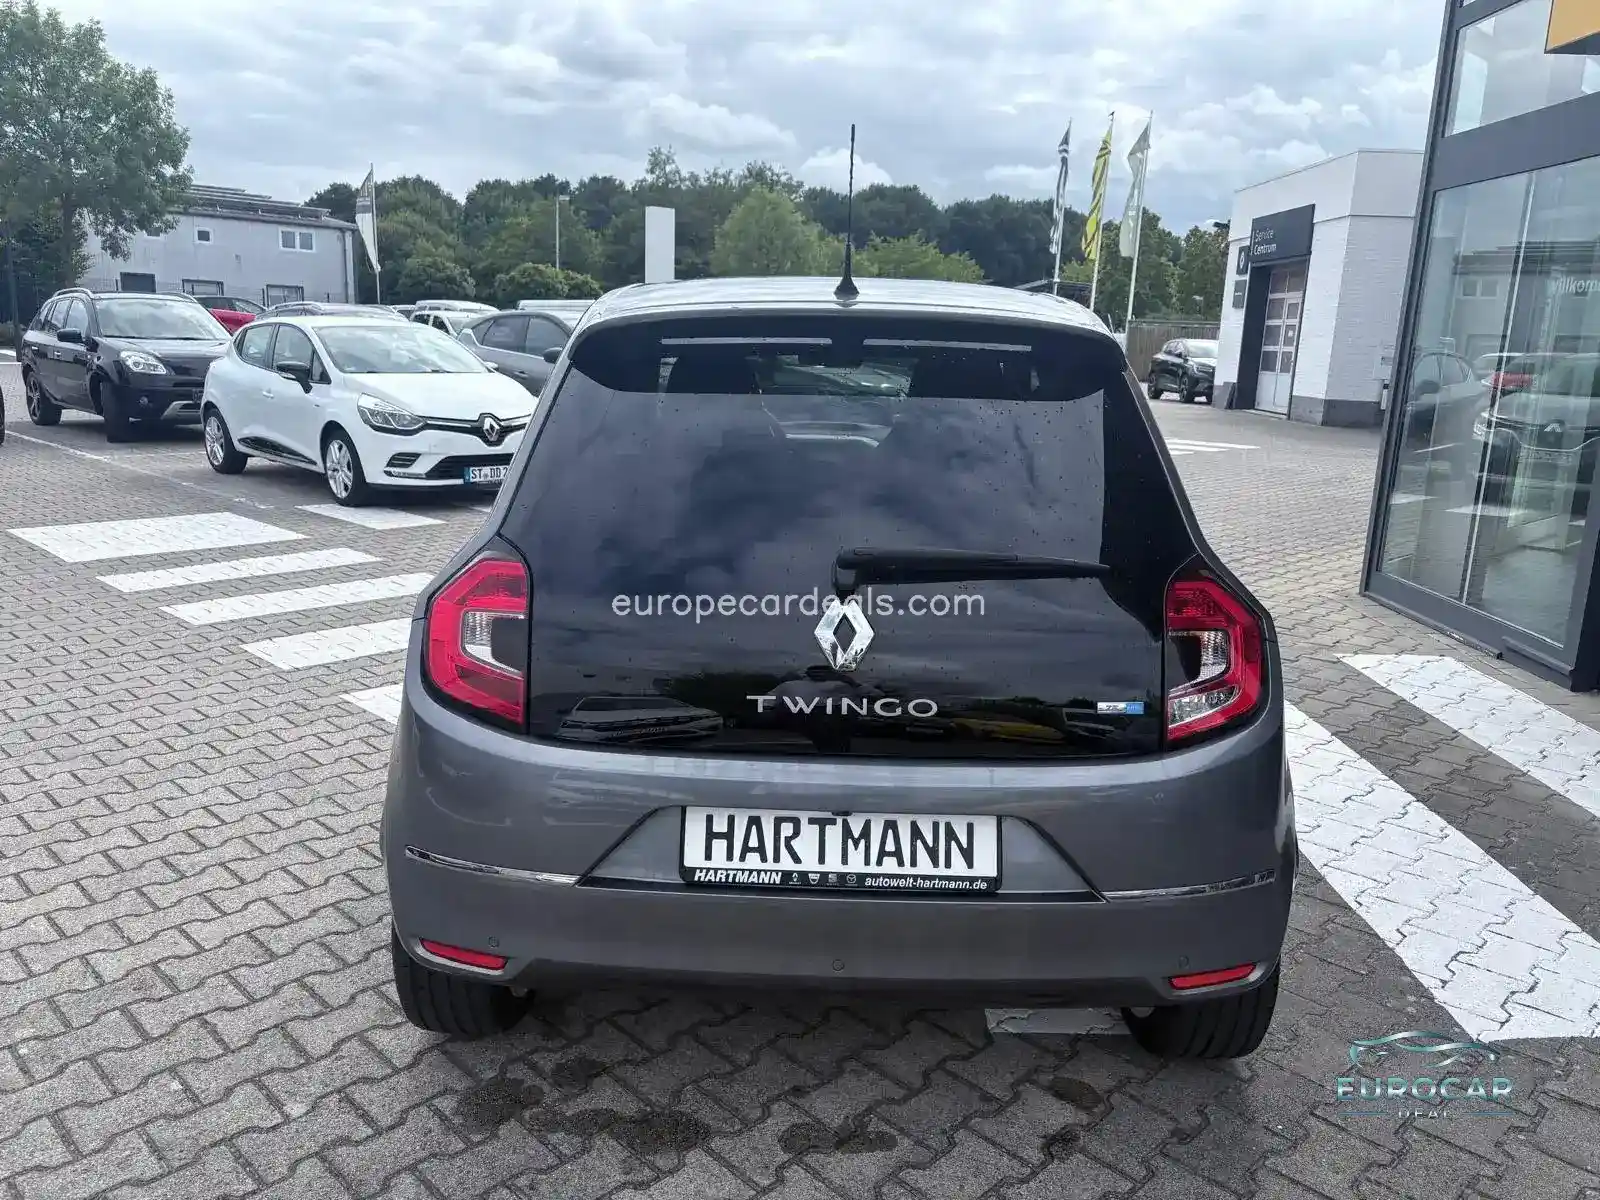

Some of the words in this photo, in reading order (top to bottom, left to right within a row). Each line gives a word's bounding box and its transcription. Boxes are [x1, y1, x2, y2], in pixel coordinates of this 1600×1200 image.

[1255, 227, 1274, 242] Service
[1254, 243, 1277, 255] Centrum
[1547, 275, 1600, 294] willkom
[471, 468, 483, 480] ST
[746, 694, 939, 718] TWINGO
[704, 813, 975, 870] HARTMANN
[693, 868, 782, 885] HARTMANN
[864, 875, 988, 891] autowelt-hartmann.de
